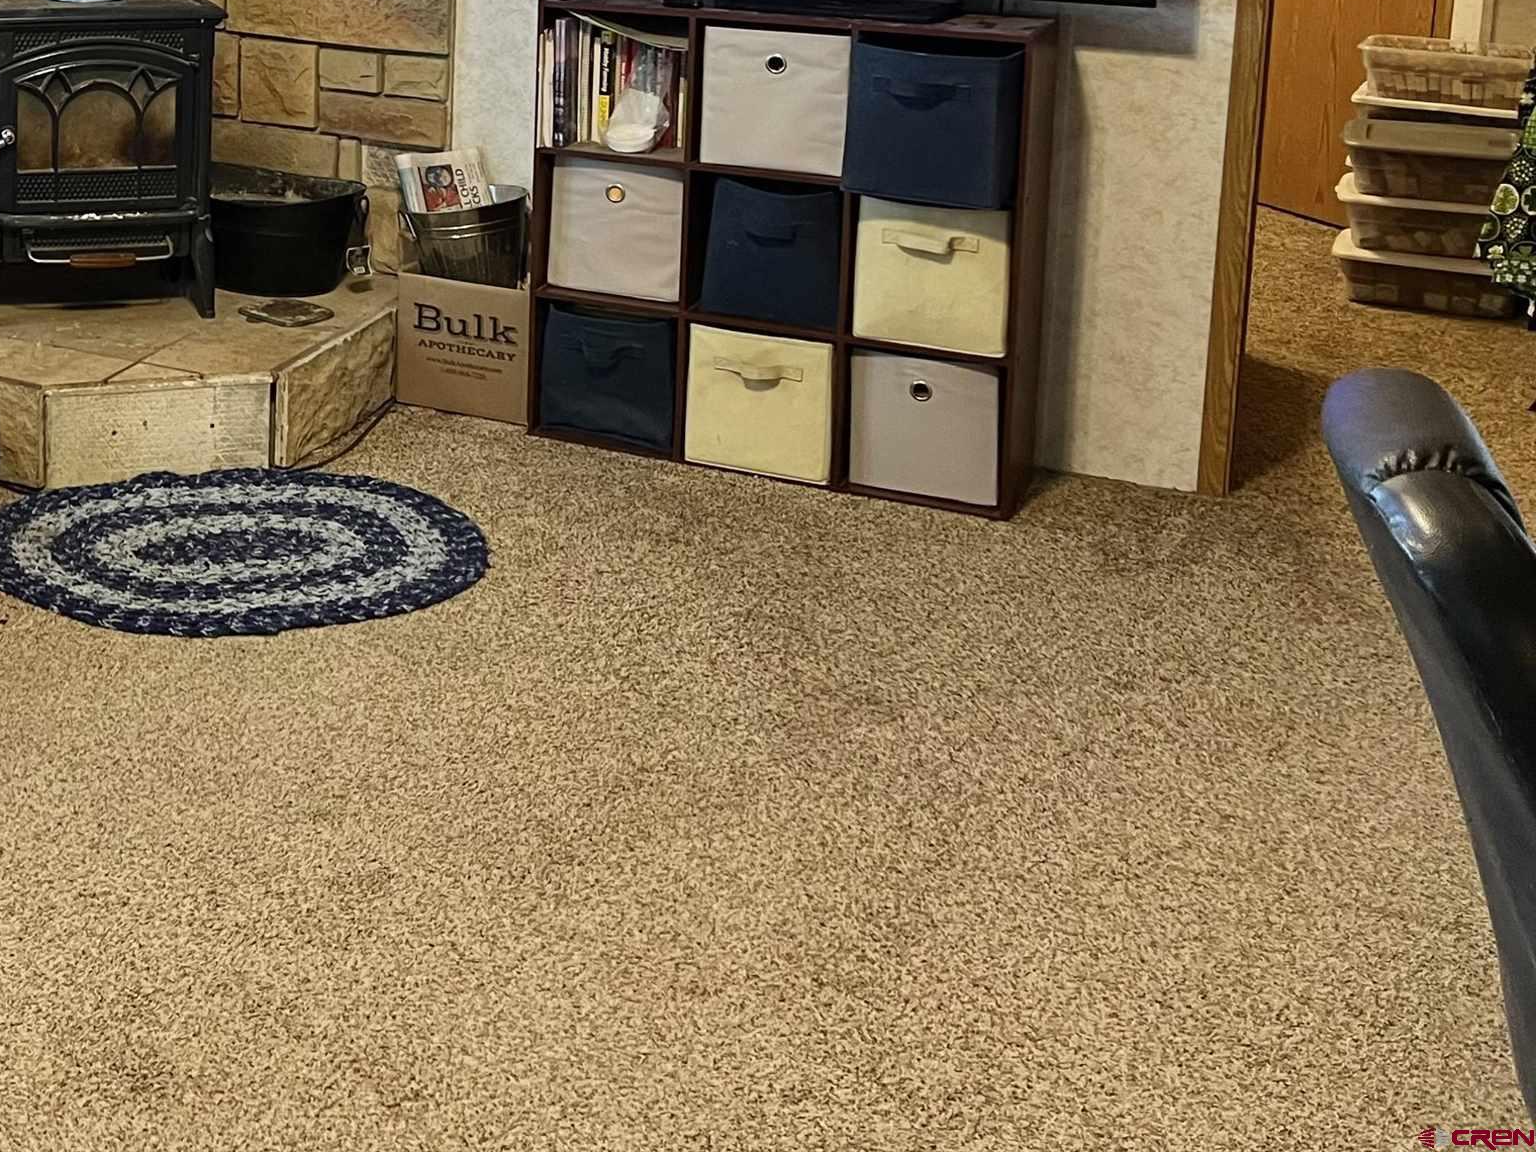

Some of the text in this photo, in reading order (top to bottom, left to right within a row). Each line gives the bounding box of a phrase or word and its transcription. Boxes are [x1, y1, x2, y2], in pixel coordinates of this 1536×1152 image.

[454, 168, 470, 198] CHILD
[413, 302, 519, 345] Bulk
[417, 338, 517, 362] APOTHECARY
